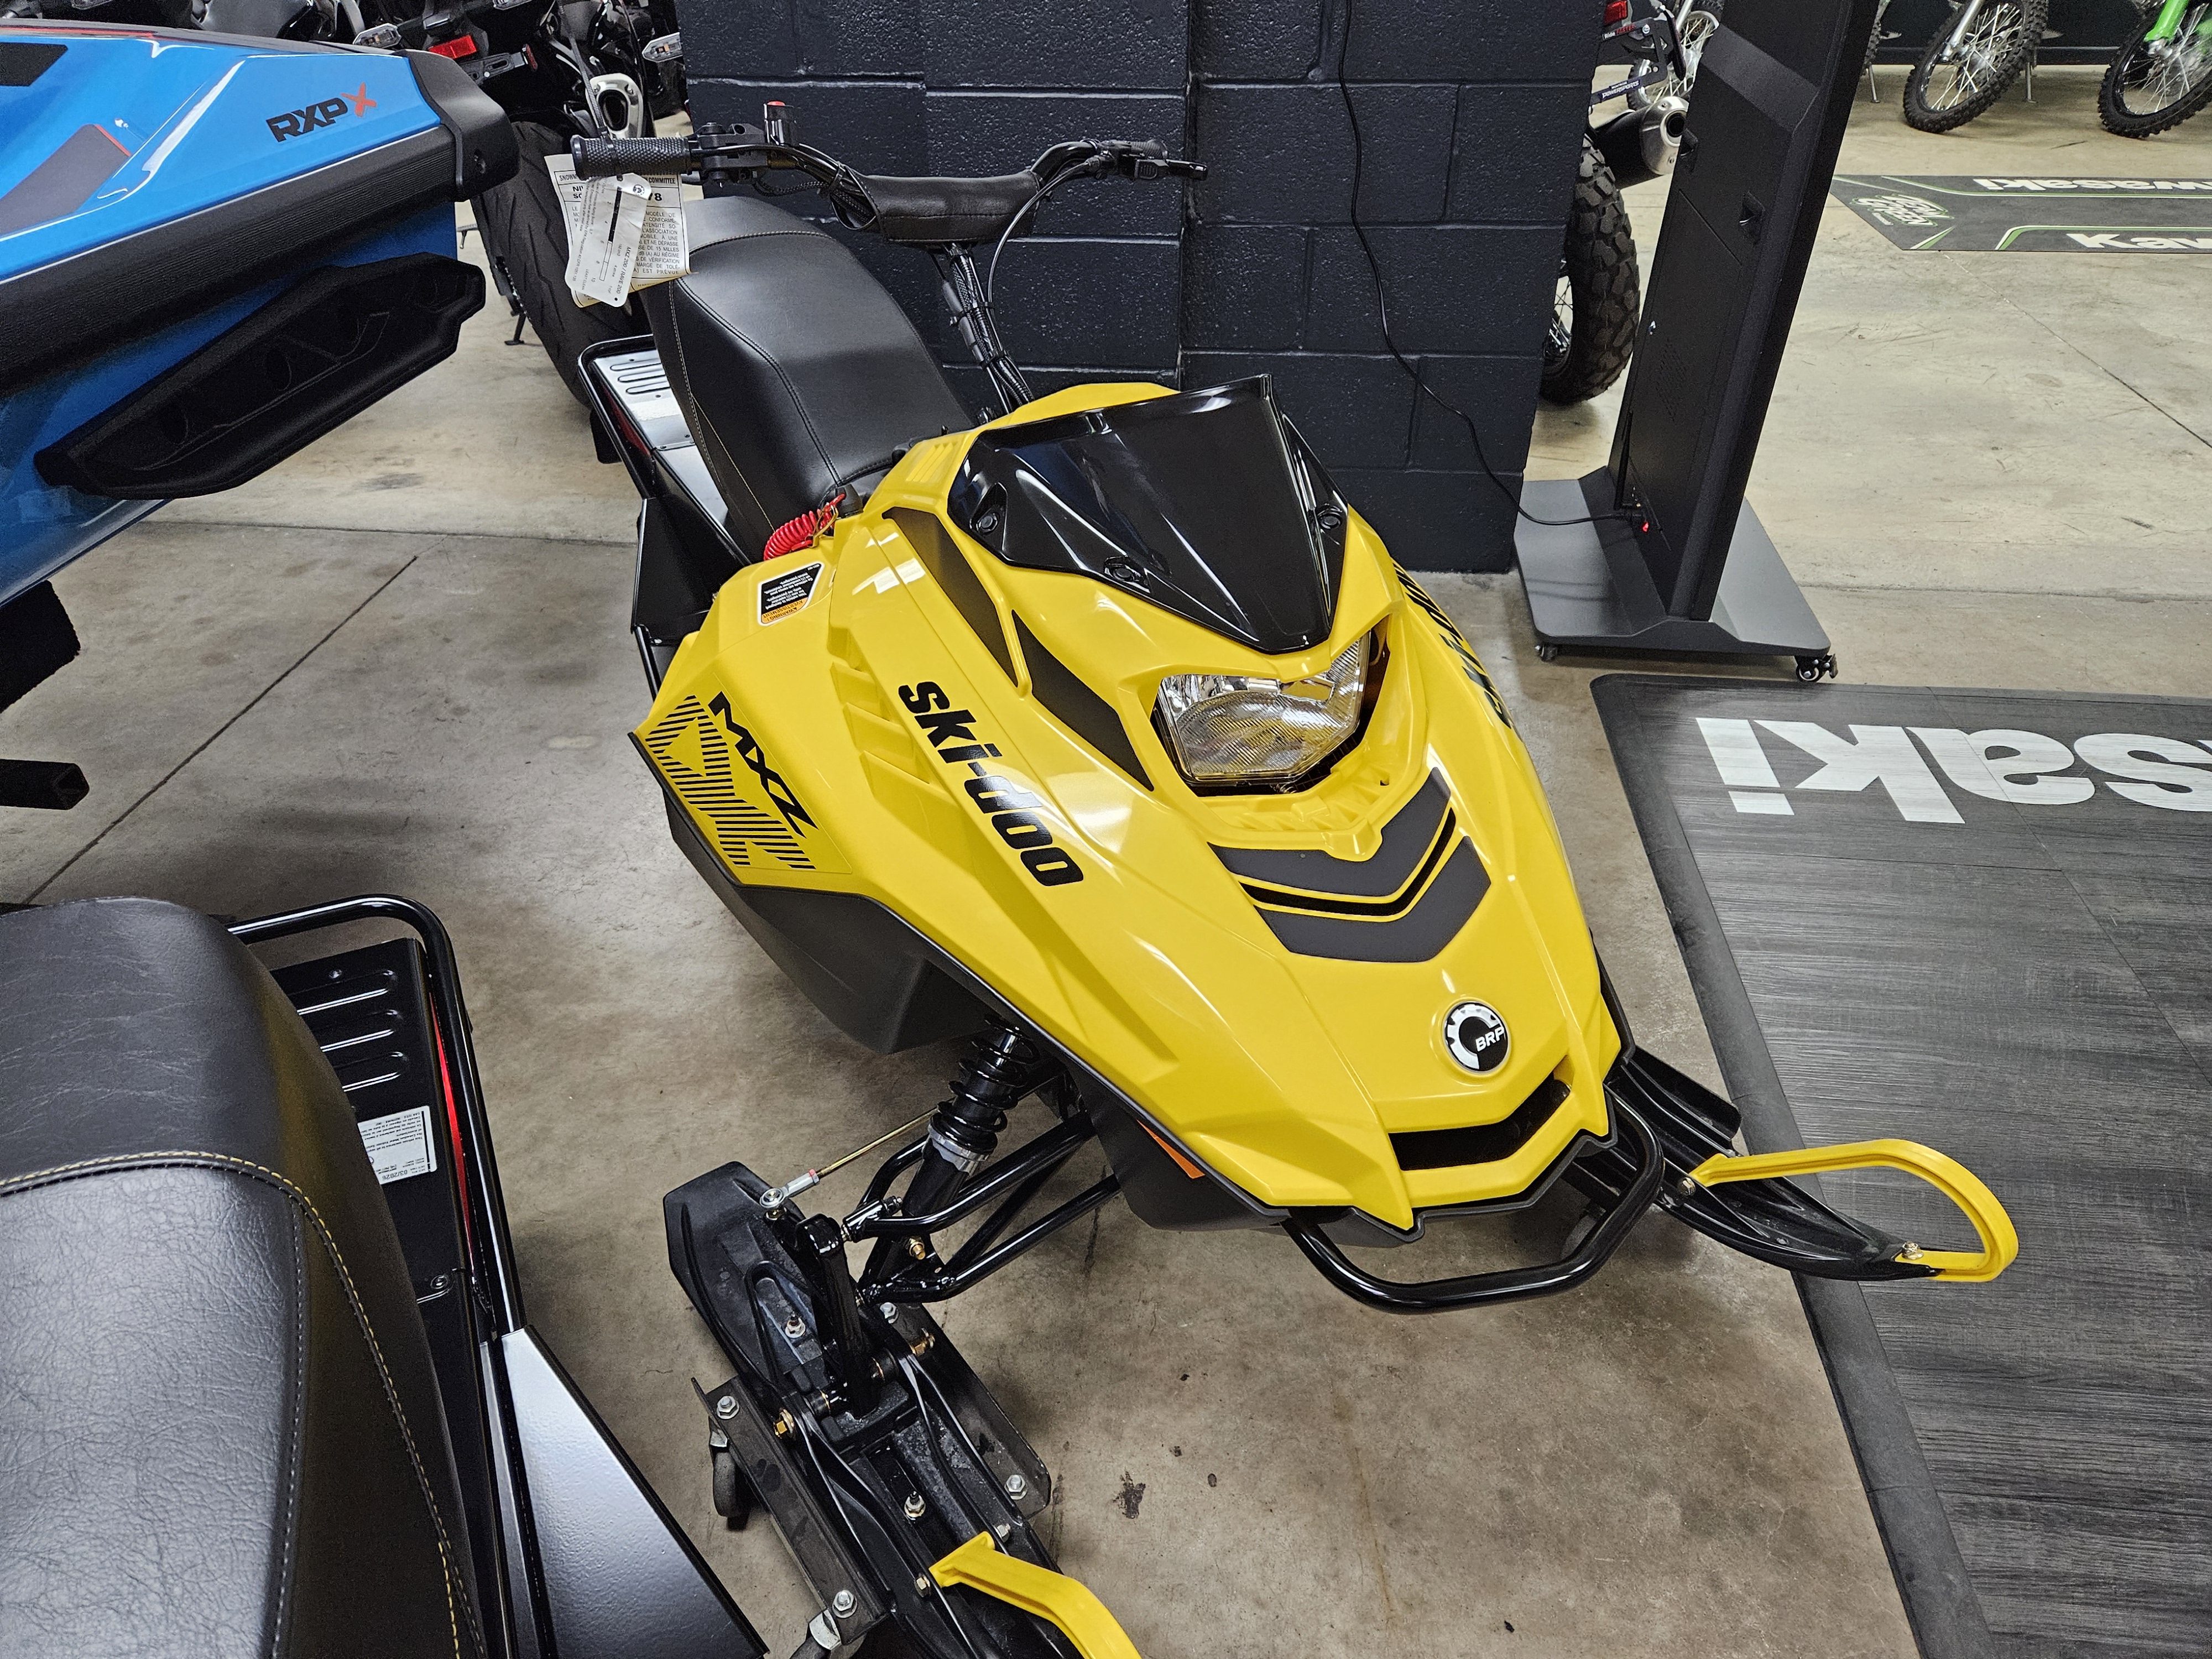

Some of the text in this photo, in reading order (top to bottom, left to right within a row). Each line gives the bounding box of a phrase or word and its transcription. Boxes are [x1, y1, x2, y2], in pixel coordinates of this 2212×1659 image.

[1616, 24, 1636, 34] FASTER
[1602, 80, 1640, 98] POWERSPORTS
[708, 691, 818, 837] MXZ
[1695, 717, 2212, 824] saki
[898, 681, 1084, 886] ski-doo
[1475, 1026, 1505, 1052] BRP
[382, 1169, 408, 1180] 03/2026
